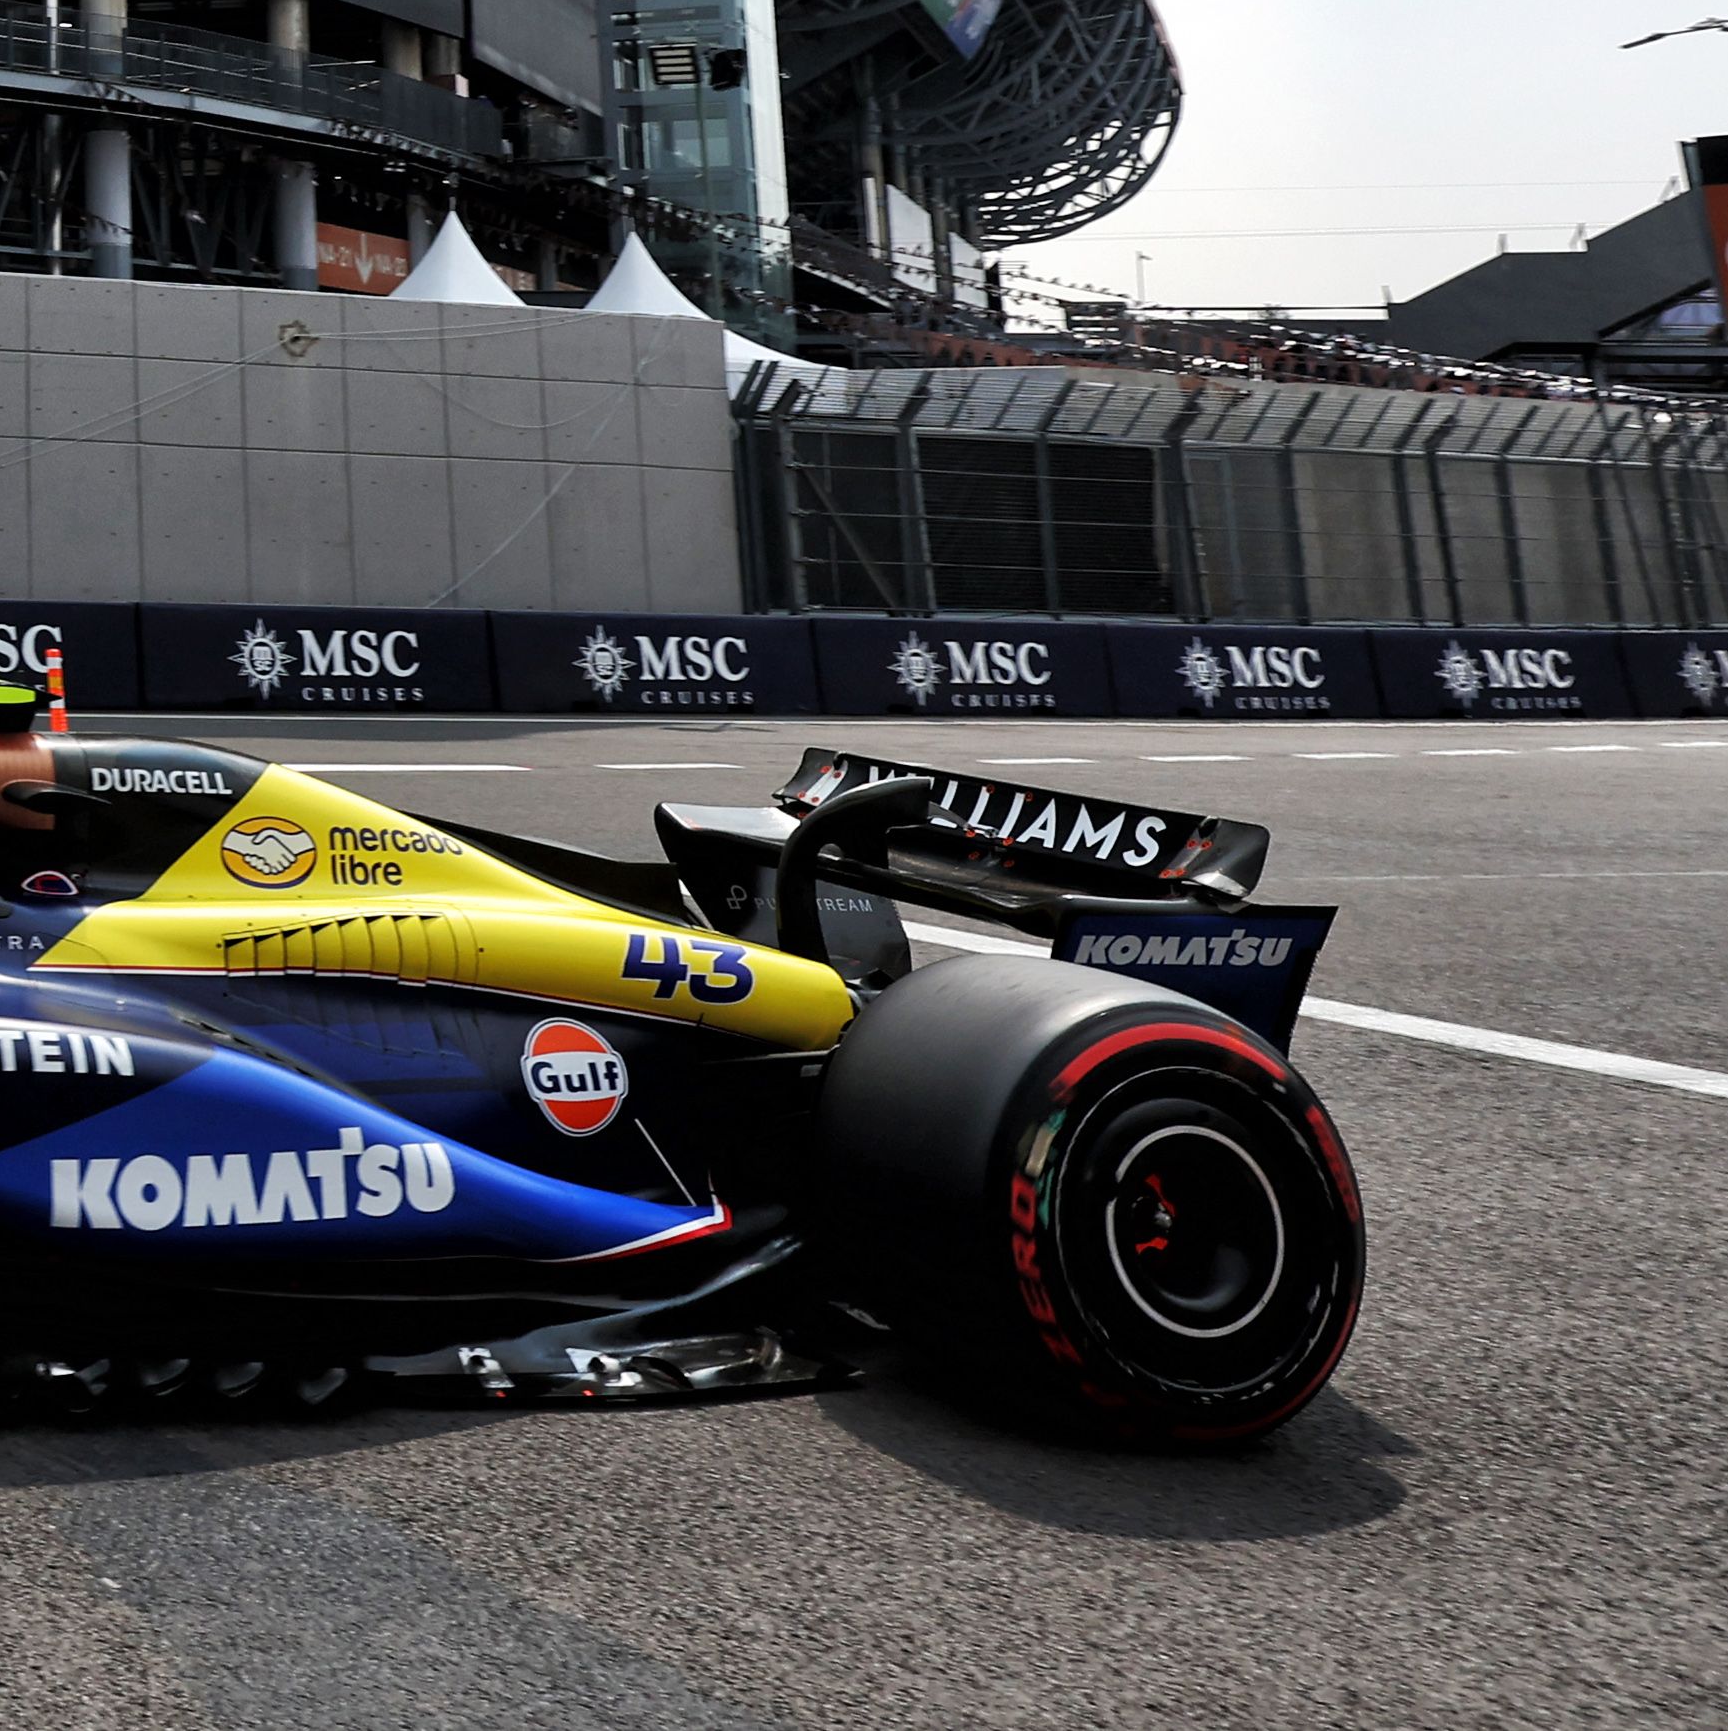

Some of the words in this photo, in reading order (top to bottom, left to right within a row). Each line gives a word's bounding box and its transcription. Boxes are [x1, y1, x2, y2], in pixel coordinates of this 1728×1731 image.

[296, 629, 420, 678] MSC
[634, 635, 750, 682] MSC
[945, 641, 1051, 685] MSC
[1223, 646, 1324, 689] MSC
[1478, 648, 1574, 689] MSC
[302, 687, 424, 701] CRUISES
[641, 690, 754, 705] CRUISES
[951, 693, 1056, 708] CRUISES
[91, 768, 233, 796] DURACELL
[329, 826, 463, 856] mercado
[330, 854, 404, 887] libre
[622, 933, 754, 1004] 43
[1074, 929, 1293, 967] KOMATSU
[531, 1054, 620, 1096] Gulf
[50, 1127, 455, 1231] KOMATSU
